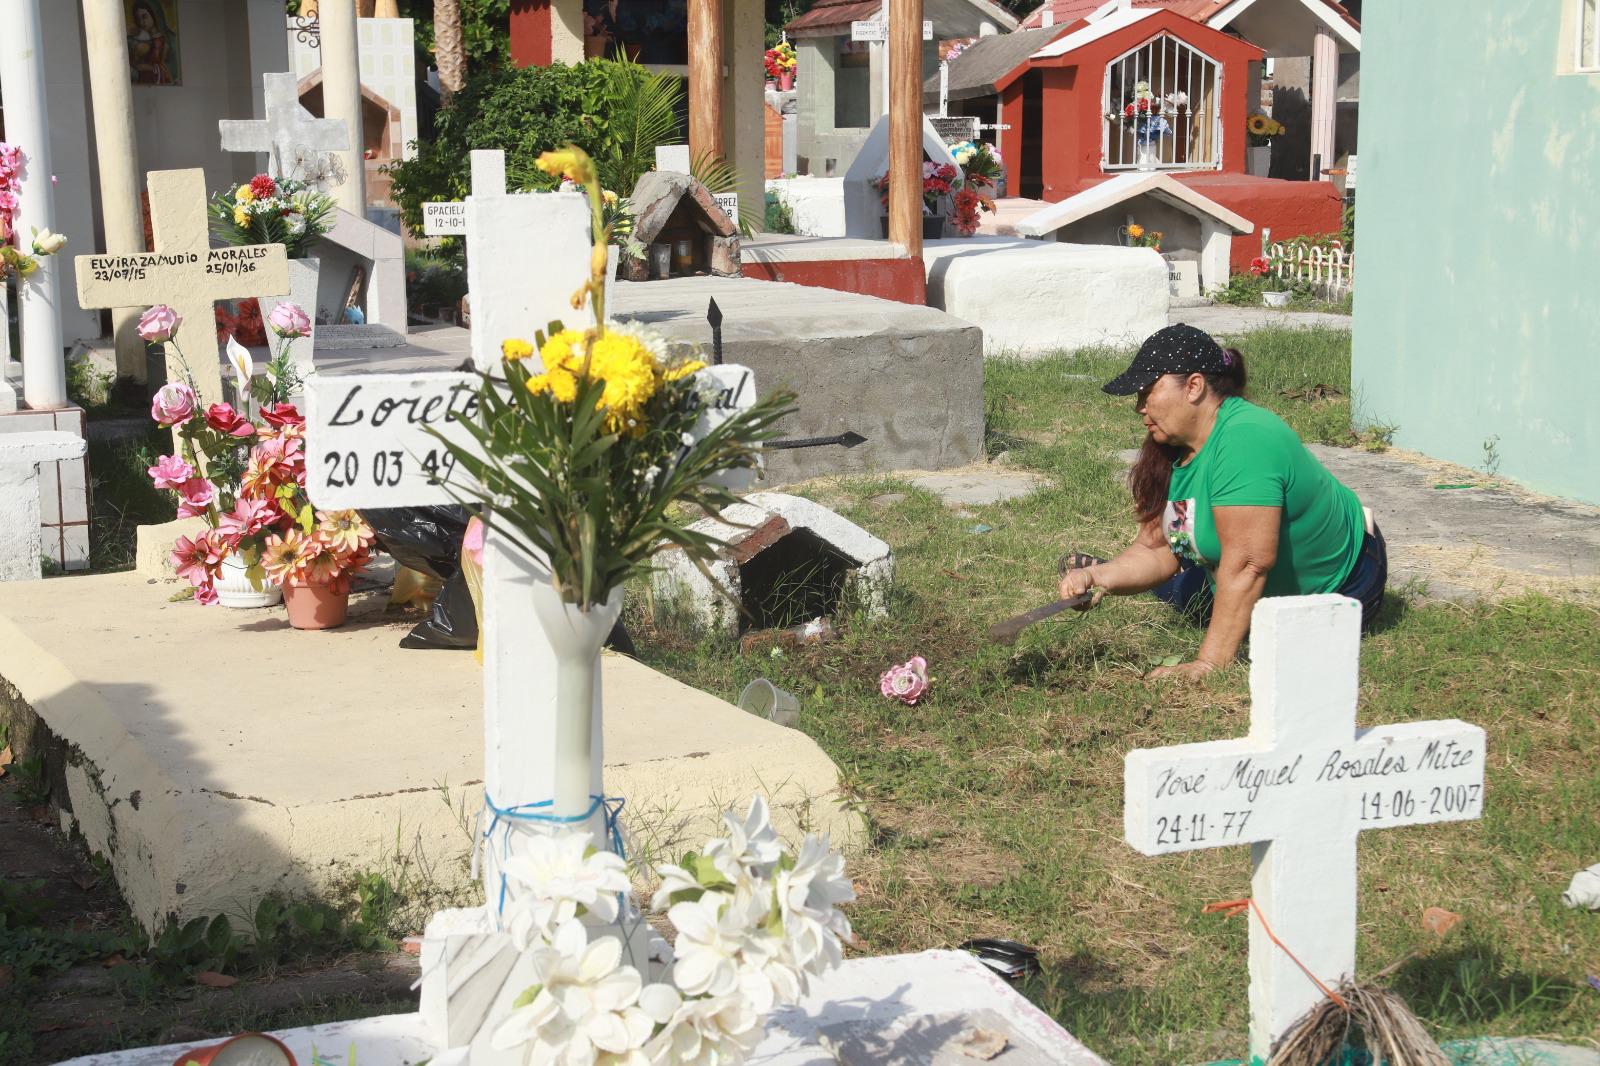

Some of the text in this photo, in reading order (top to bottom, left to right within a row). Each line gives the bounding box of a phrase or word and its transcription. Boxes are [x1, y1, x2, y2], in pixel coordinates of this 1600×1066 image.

[715, 197, 737, 206] RREZ
[94, 259, 256, 282] 23/07/15 25/01/36
[207, 248, 268, 261] MORALES
[328, 383, 480, 427] Loreto
[324, 449, 456, 488] 20 03 49
[1155, 739, 1474, 803] José Miguel Rosales Mitre
[1360, 784, 1481, 820] 14-06-2007
